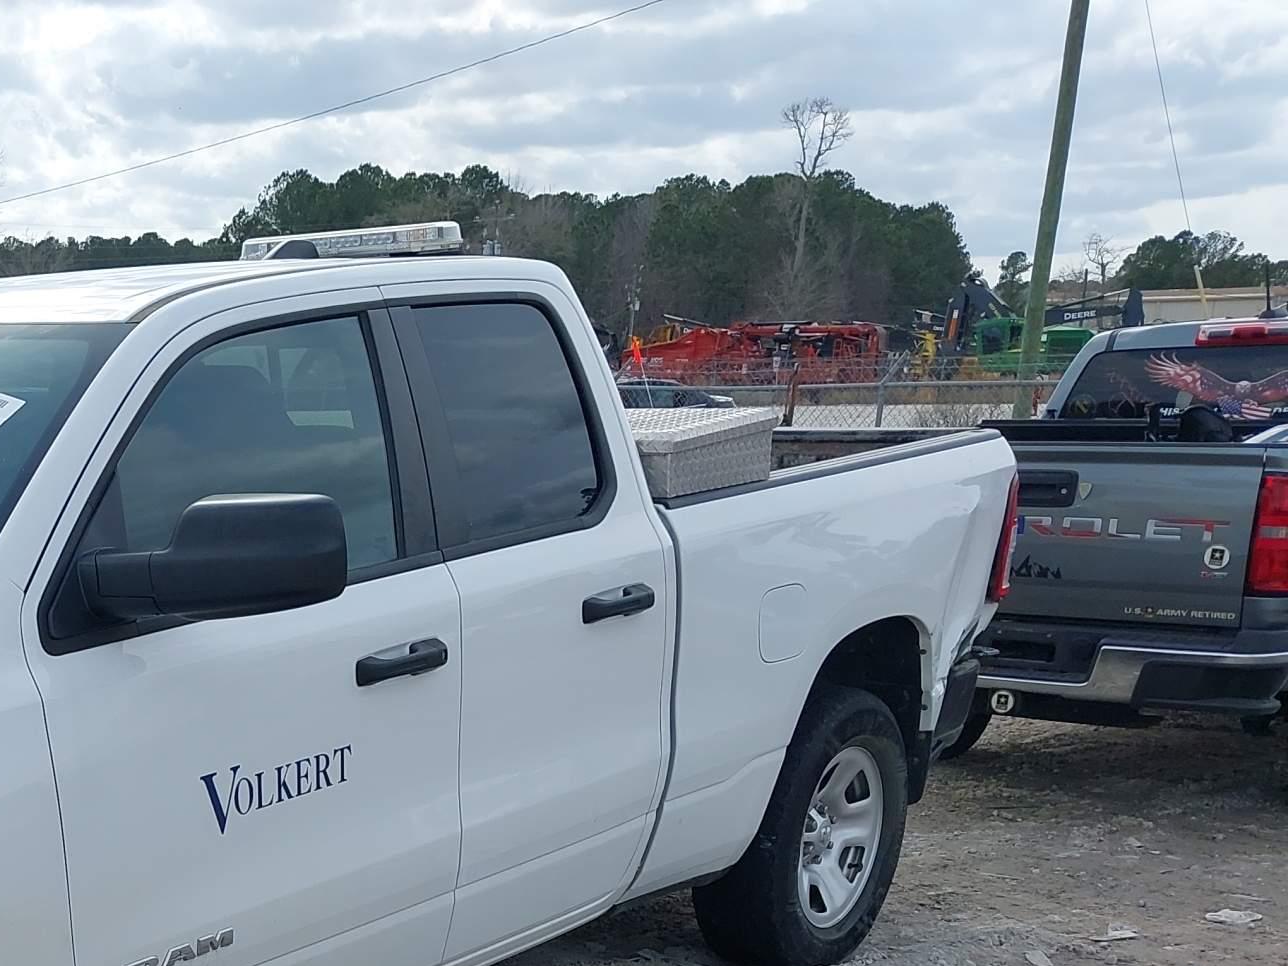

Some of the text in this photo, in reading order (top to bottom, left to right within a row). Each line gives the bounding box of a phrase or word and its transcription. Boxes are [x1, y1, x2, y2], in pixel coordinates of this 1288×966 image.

[1064, 310, 1097, 321] DEERE
[1156, 608, 1188, 617] ARMY
[1191, 610, 1236, 620] RETIRED
